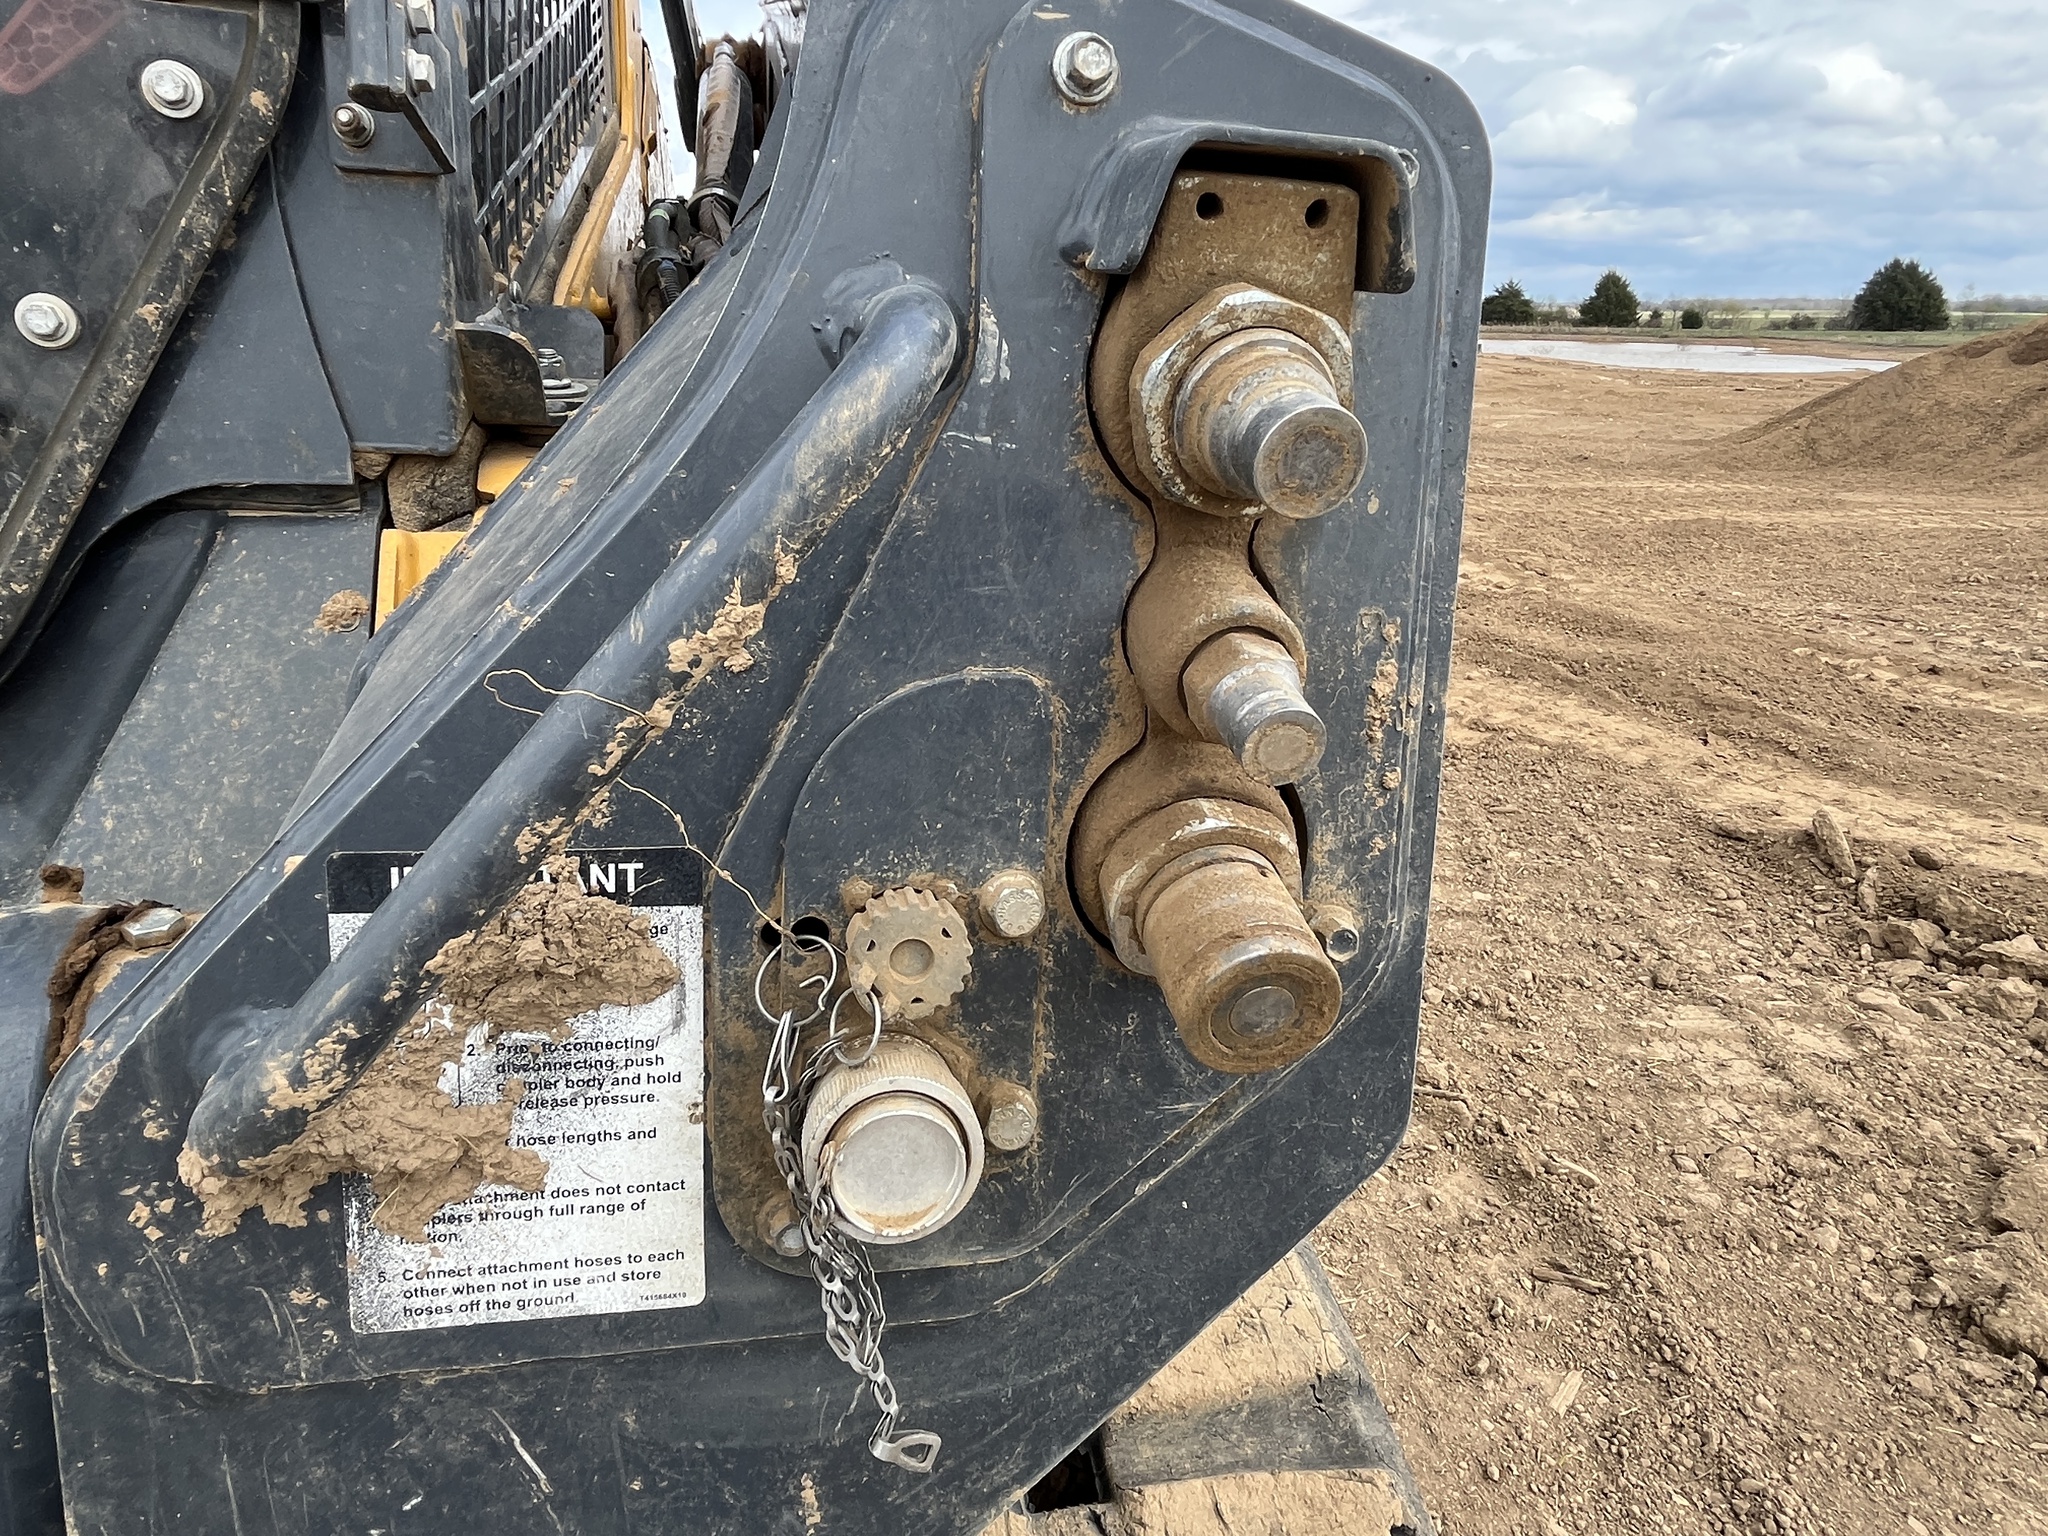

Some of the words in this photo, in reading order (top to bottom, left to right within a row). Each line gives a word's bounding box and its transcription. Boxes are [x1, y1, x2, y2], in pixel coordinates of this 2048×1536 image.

[466, 1043, 481, 1057] 2.
[496, 1042, 531, 1056] Prio
[541, 1041, 558, 1053] to
[563, 1036, 660, 1053] connecting/
[624, 1054, 665, 1073] push
[496, 1077, 559, 1094] cpler
[565, 1075, 606, 1089] body
[611, 1073, 641, 1086] and
[647, 1071, 682, 1085] hold
[519, 1096, 578, 1111] release
[585, 1093, 660, 1108] pressure.
[517, 1134, 556, 1148] hose
[562, 1130, 622, 1146] lengths
[628, 1127, 657, 1140] and
[551, 1187, 590, 1199] does
[596, 1184, 622, 1196] not
[627, 1179, 686, 1194] contact
[424, 1212, 473, 1229] plers
[478, 1206, 544, 1222] through
[549, 1204, 574, 1217] full
[580, 1203, 625, 1216] range
[631, 1199, 647, 1211] of
[378, 1271, 391, 1284] 5.
[478, 1258, 569, 1276] attachment
[574, 1255, 622, 1269] hoses
[627, 1253, 643, 1264] to
[648, 1249, 685, 1263] each
[403, 1286, 446, 1299] other
[452, 1283, 496, 1296] when
[501, 1279, 528, 1292] not
[533, 1277, 547, 1289] in
[553, 1276, 581, 1288] use
[587, 1271, 616, 1284] and
[621, 1270, 661, 1282] store
[403, 1304, 453, 1317] hoses
[459, 1300, 480, 1313] off
[486, 1299, 511, 1311] the
[517, 1292, 579, 1311] ground.
